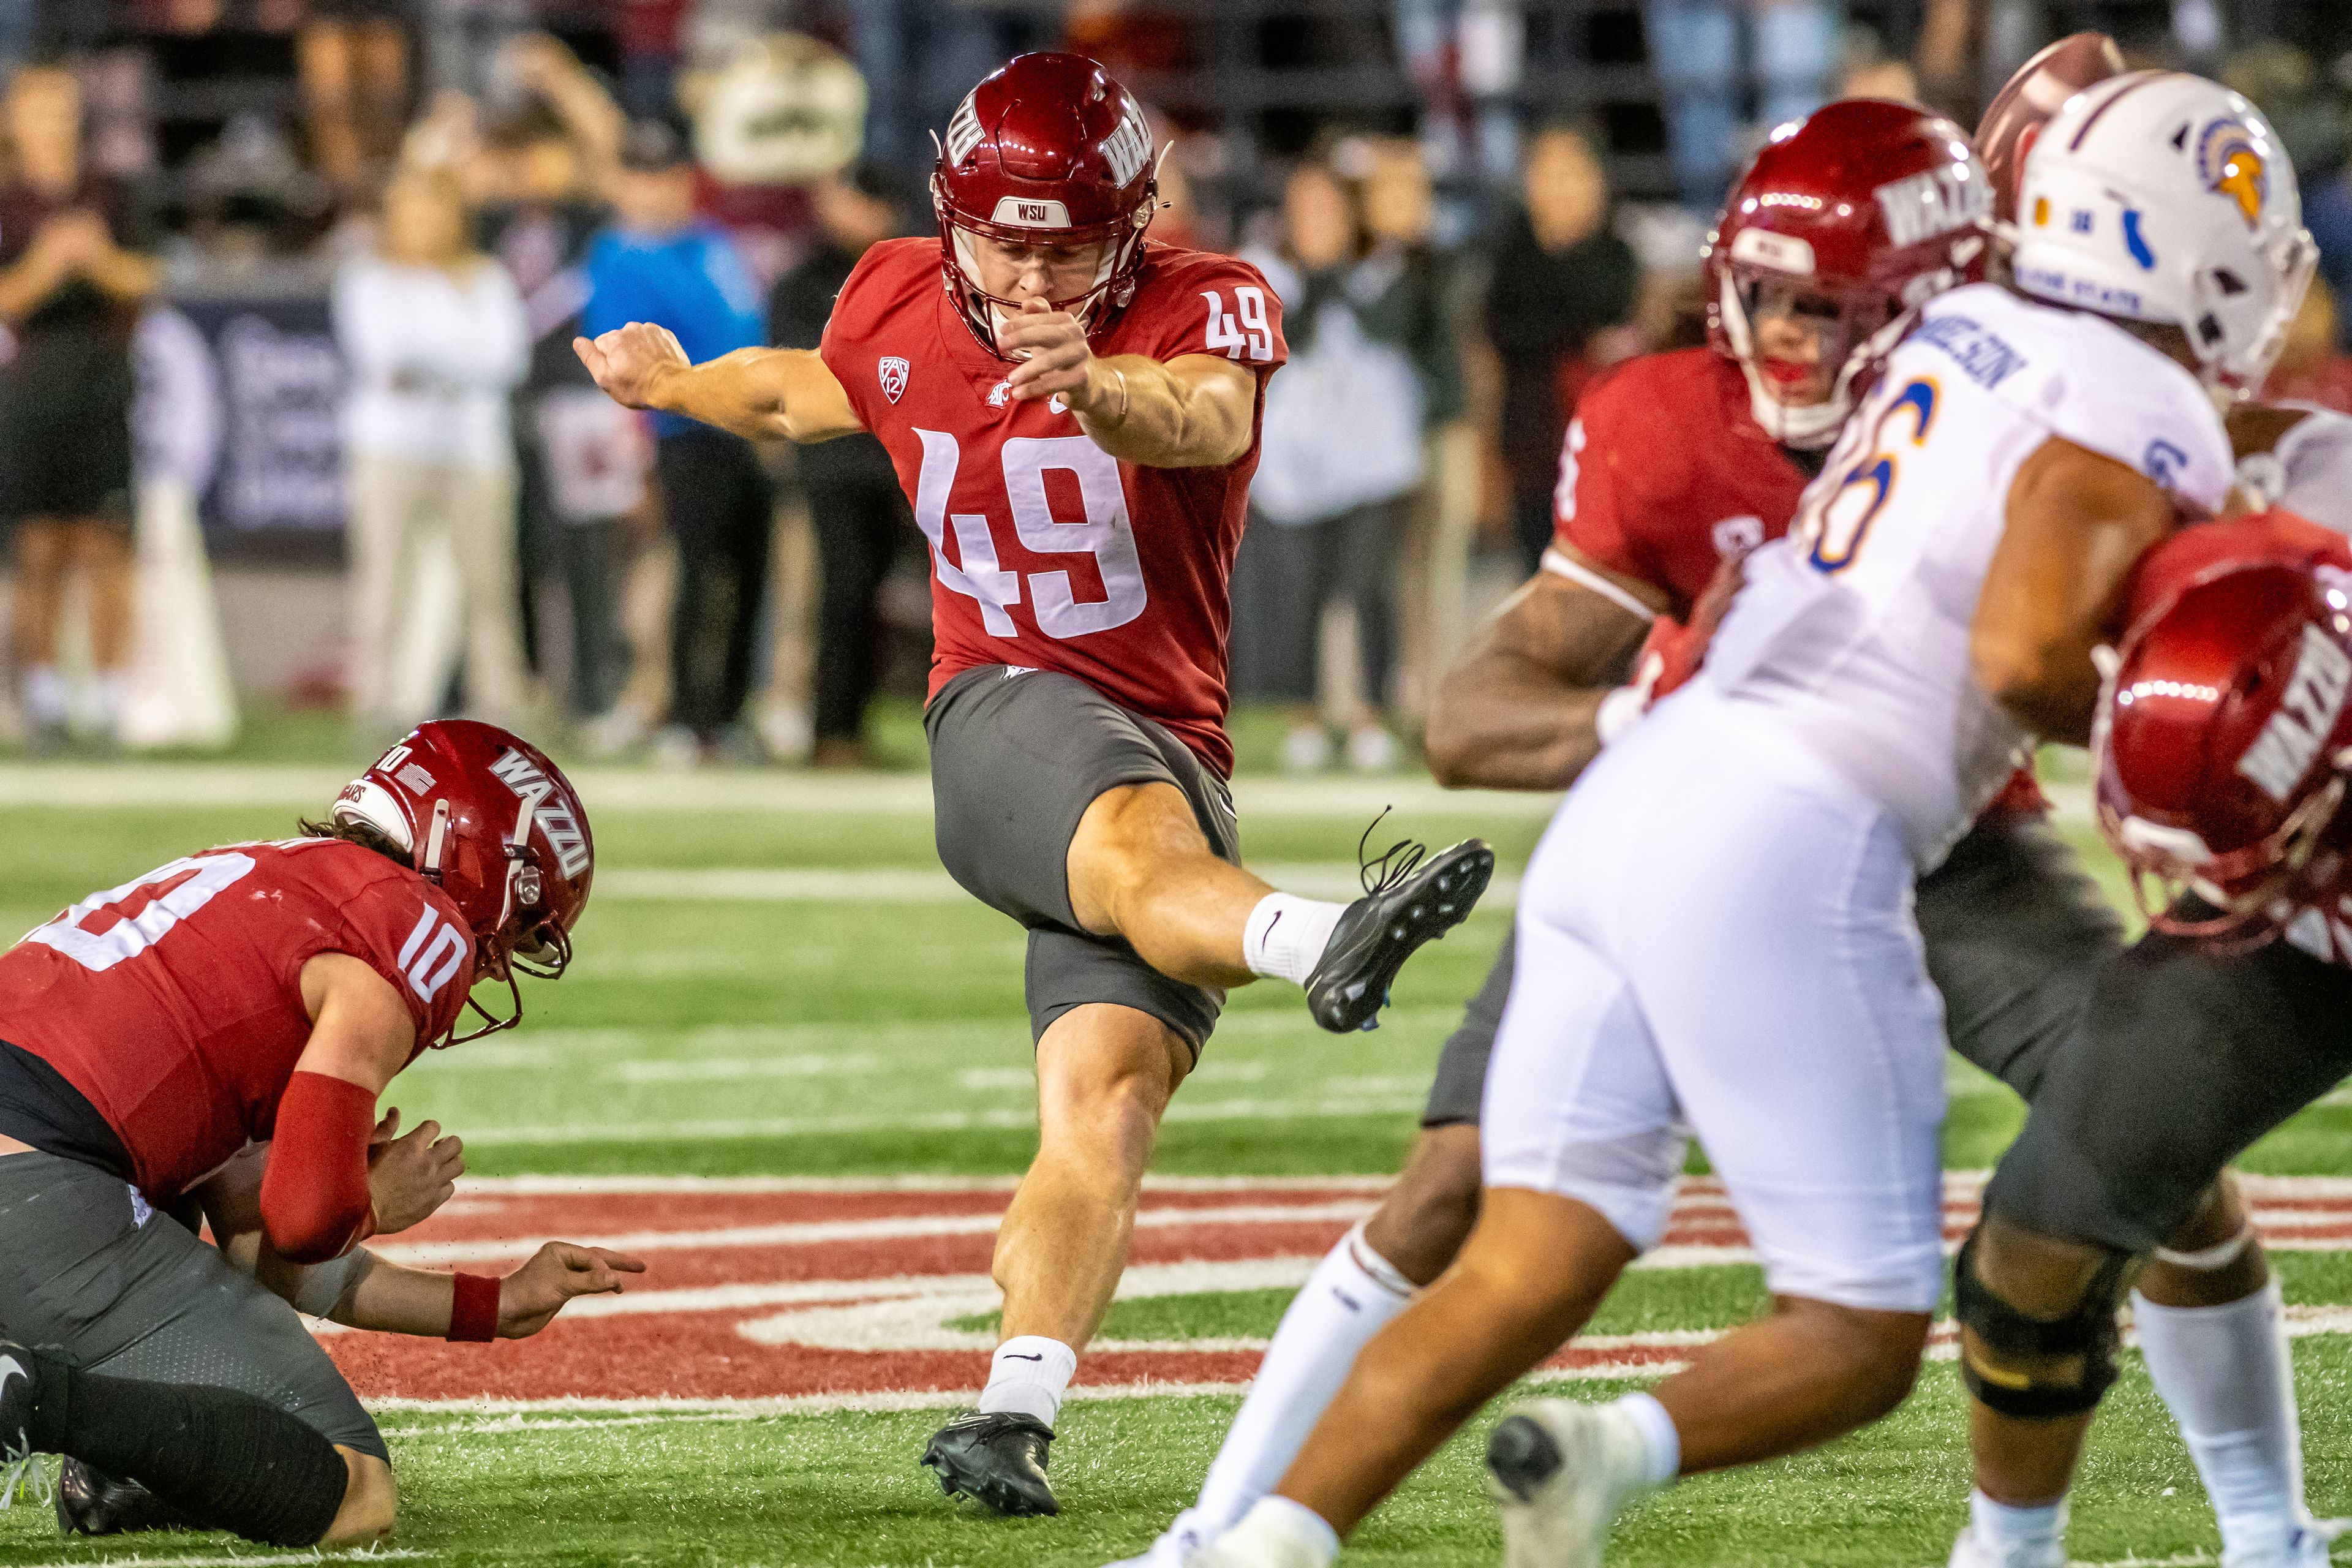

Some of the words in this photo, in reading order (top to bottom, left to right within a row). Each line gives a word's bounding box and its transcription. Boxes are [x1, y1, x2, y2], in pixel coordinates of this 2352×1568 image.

[1017, 203, 1047, 221] WSU
[1199, 286, 1274, 361] 49
[880, 358, 908, 387] PAC
[886, 376, 900, 394] 12
[911, 427, 1147, 639] 49
[488, 745, 593, 881] WAZZU
[398, 902, 468, 1003] 10
